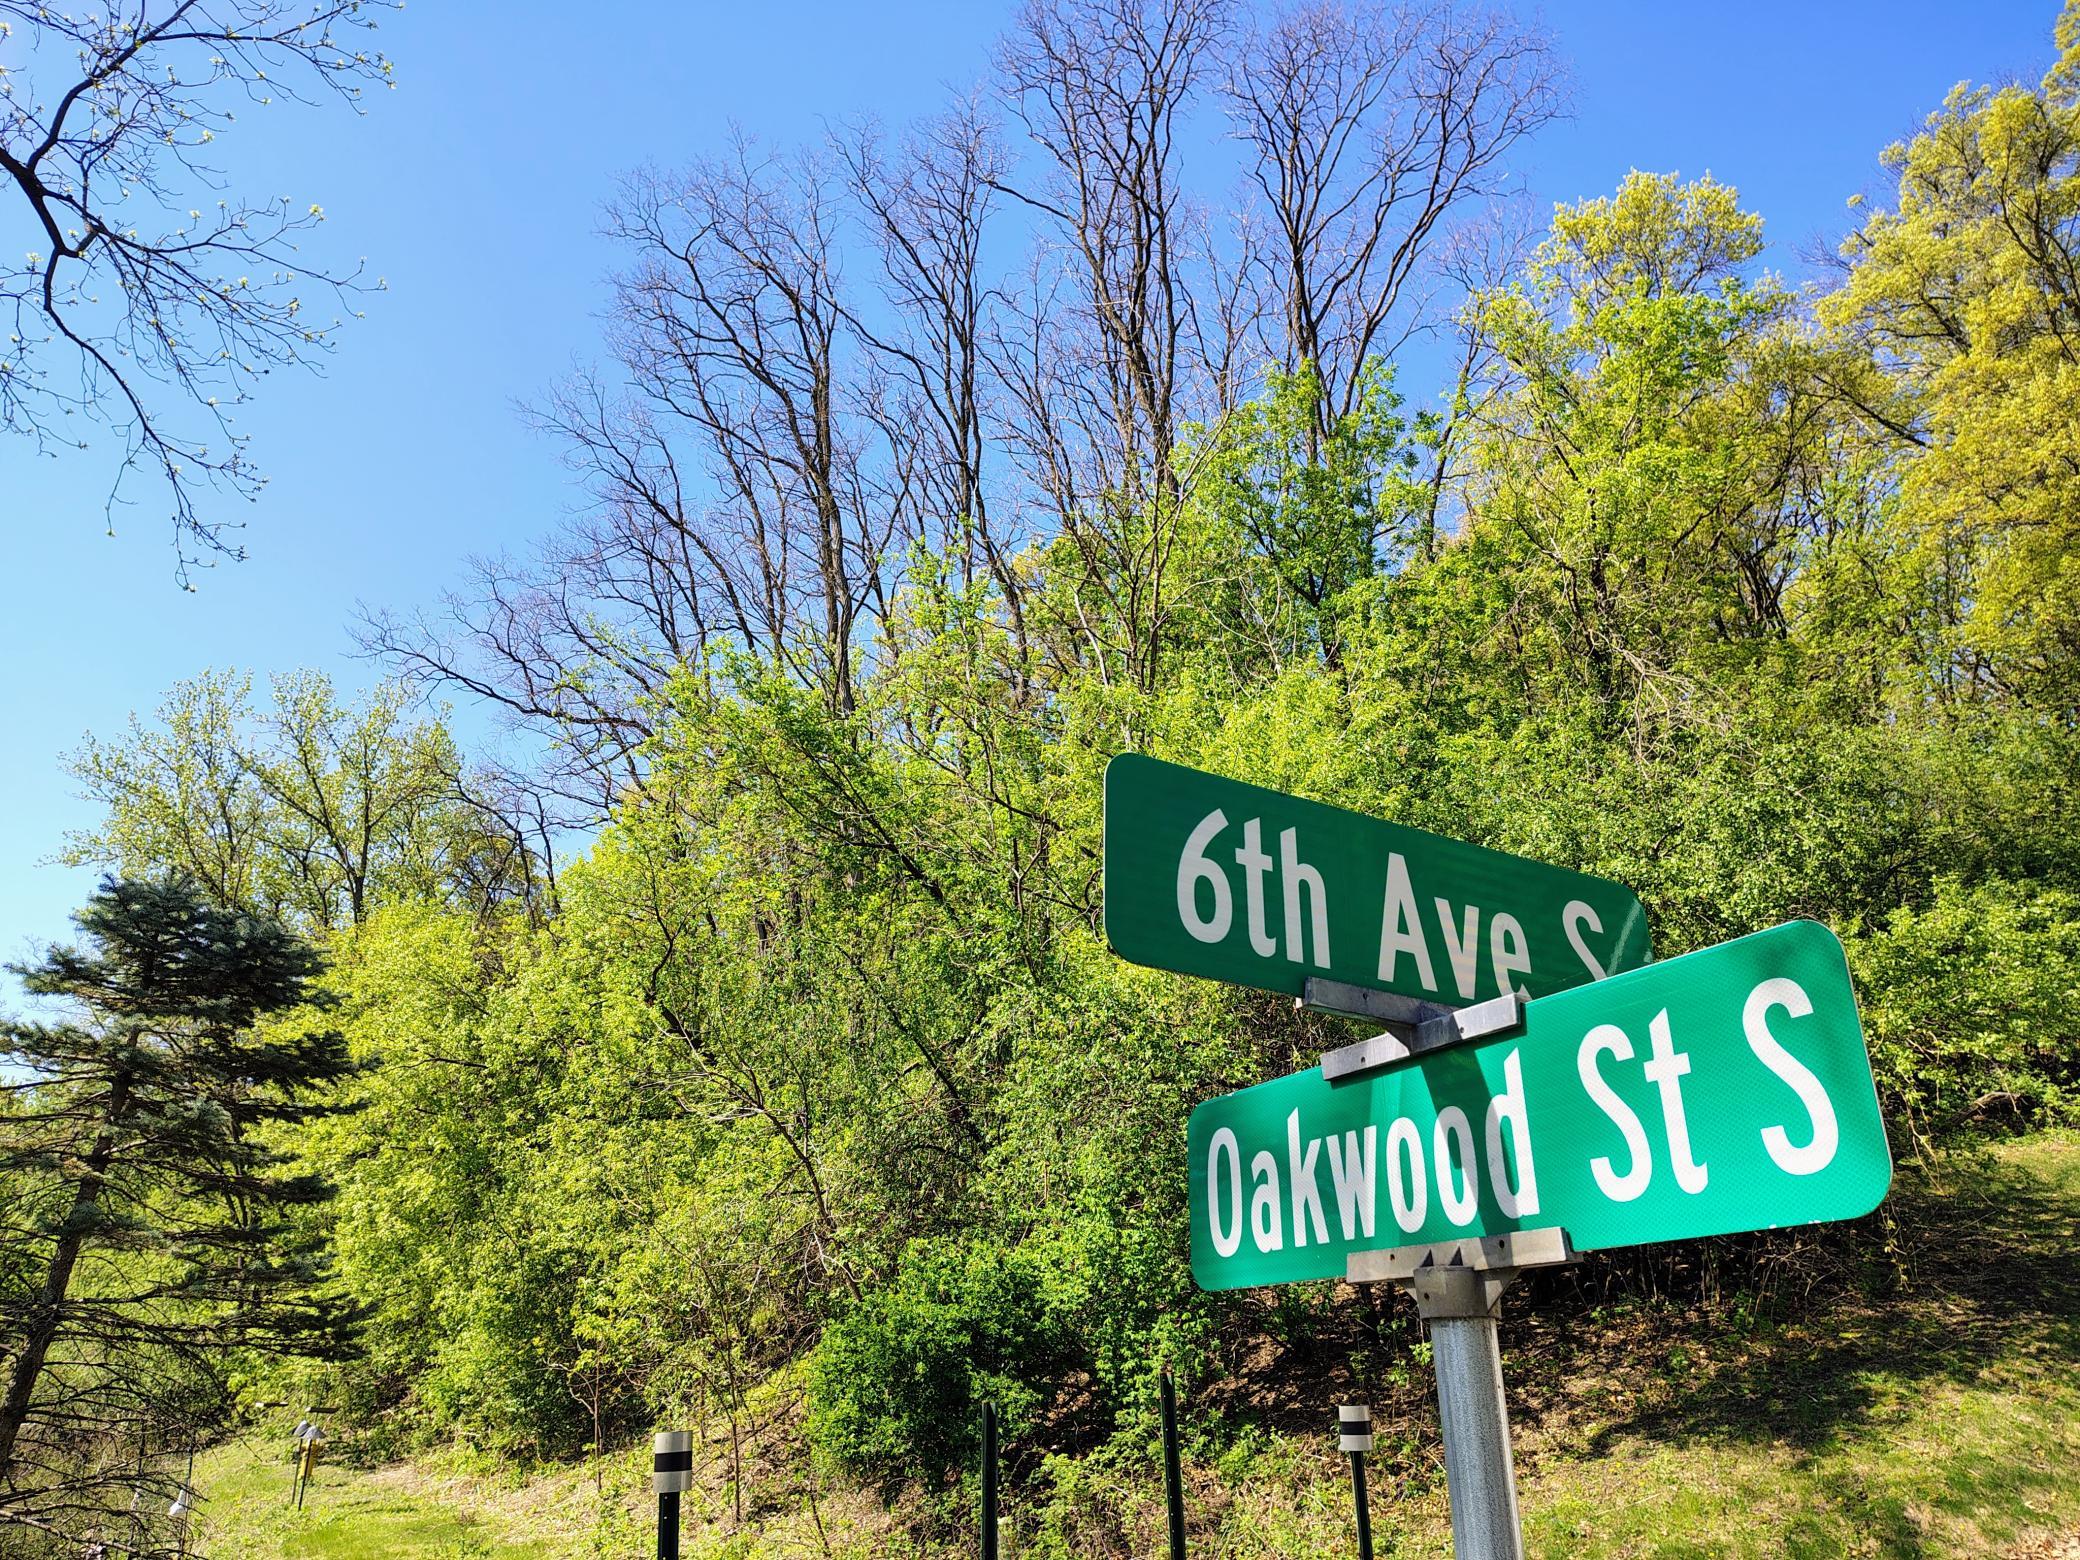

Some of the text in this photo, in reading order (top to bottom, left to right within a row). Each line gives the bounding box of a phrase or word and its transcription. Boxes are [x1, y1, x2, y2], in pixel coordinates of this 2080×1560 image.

[1176, 808, 1607, 999] 6th Ave S
[1207, 977, 1839, 1258] Oakwood St S
